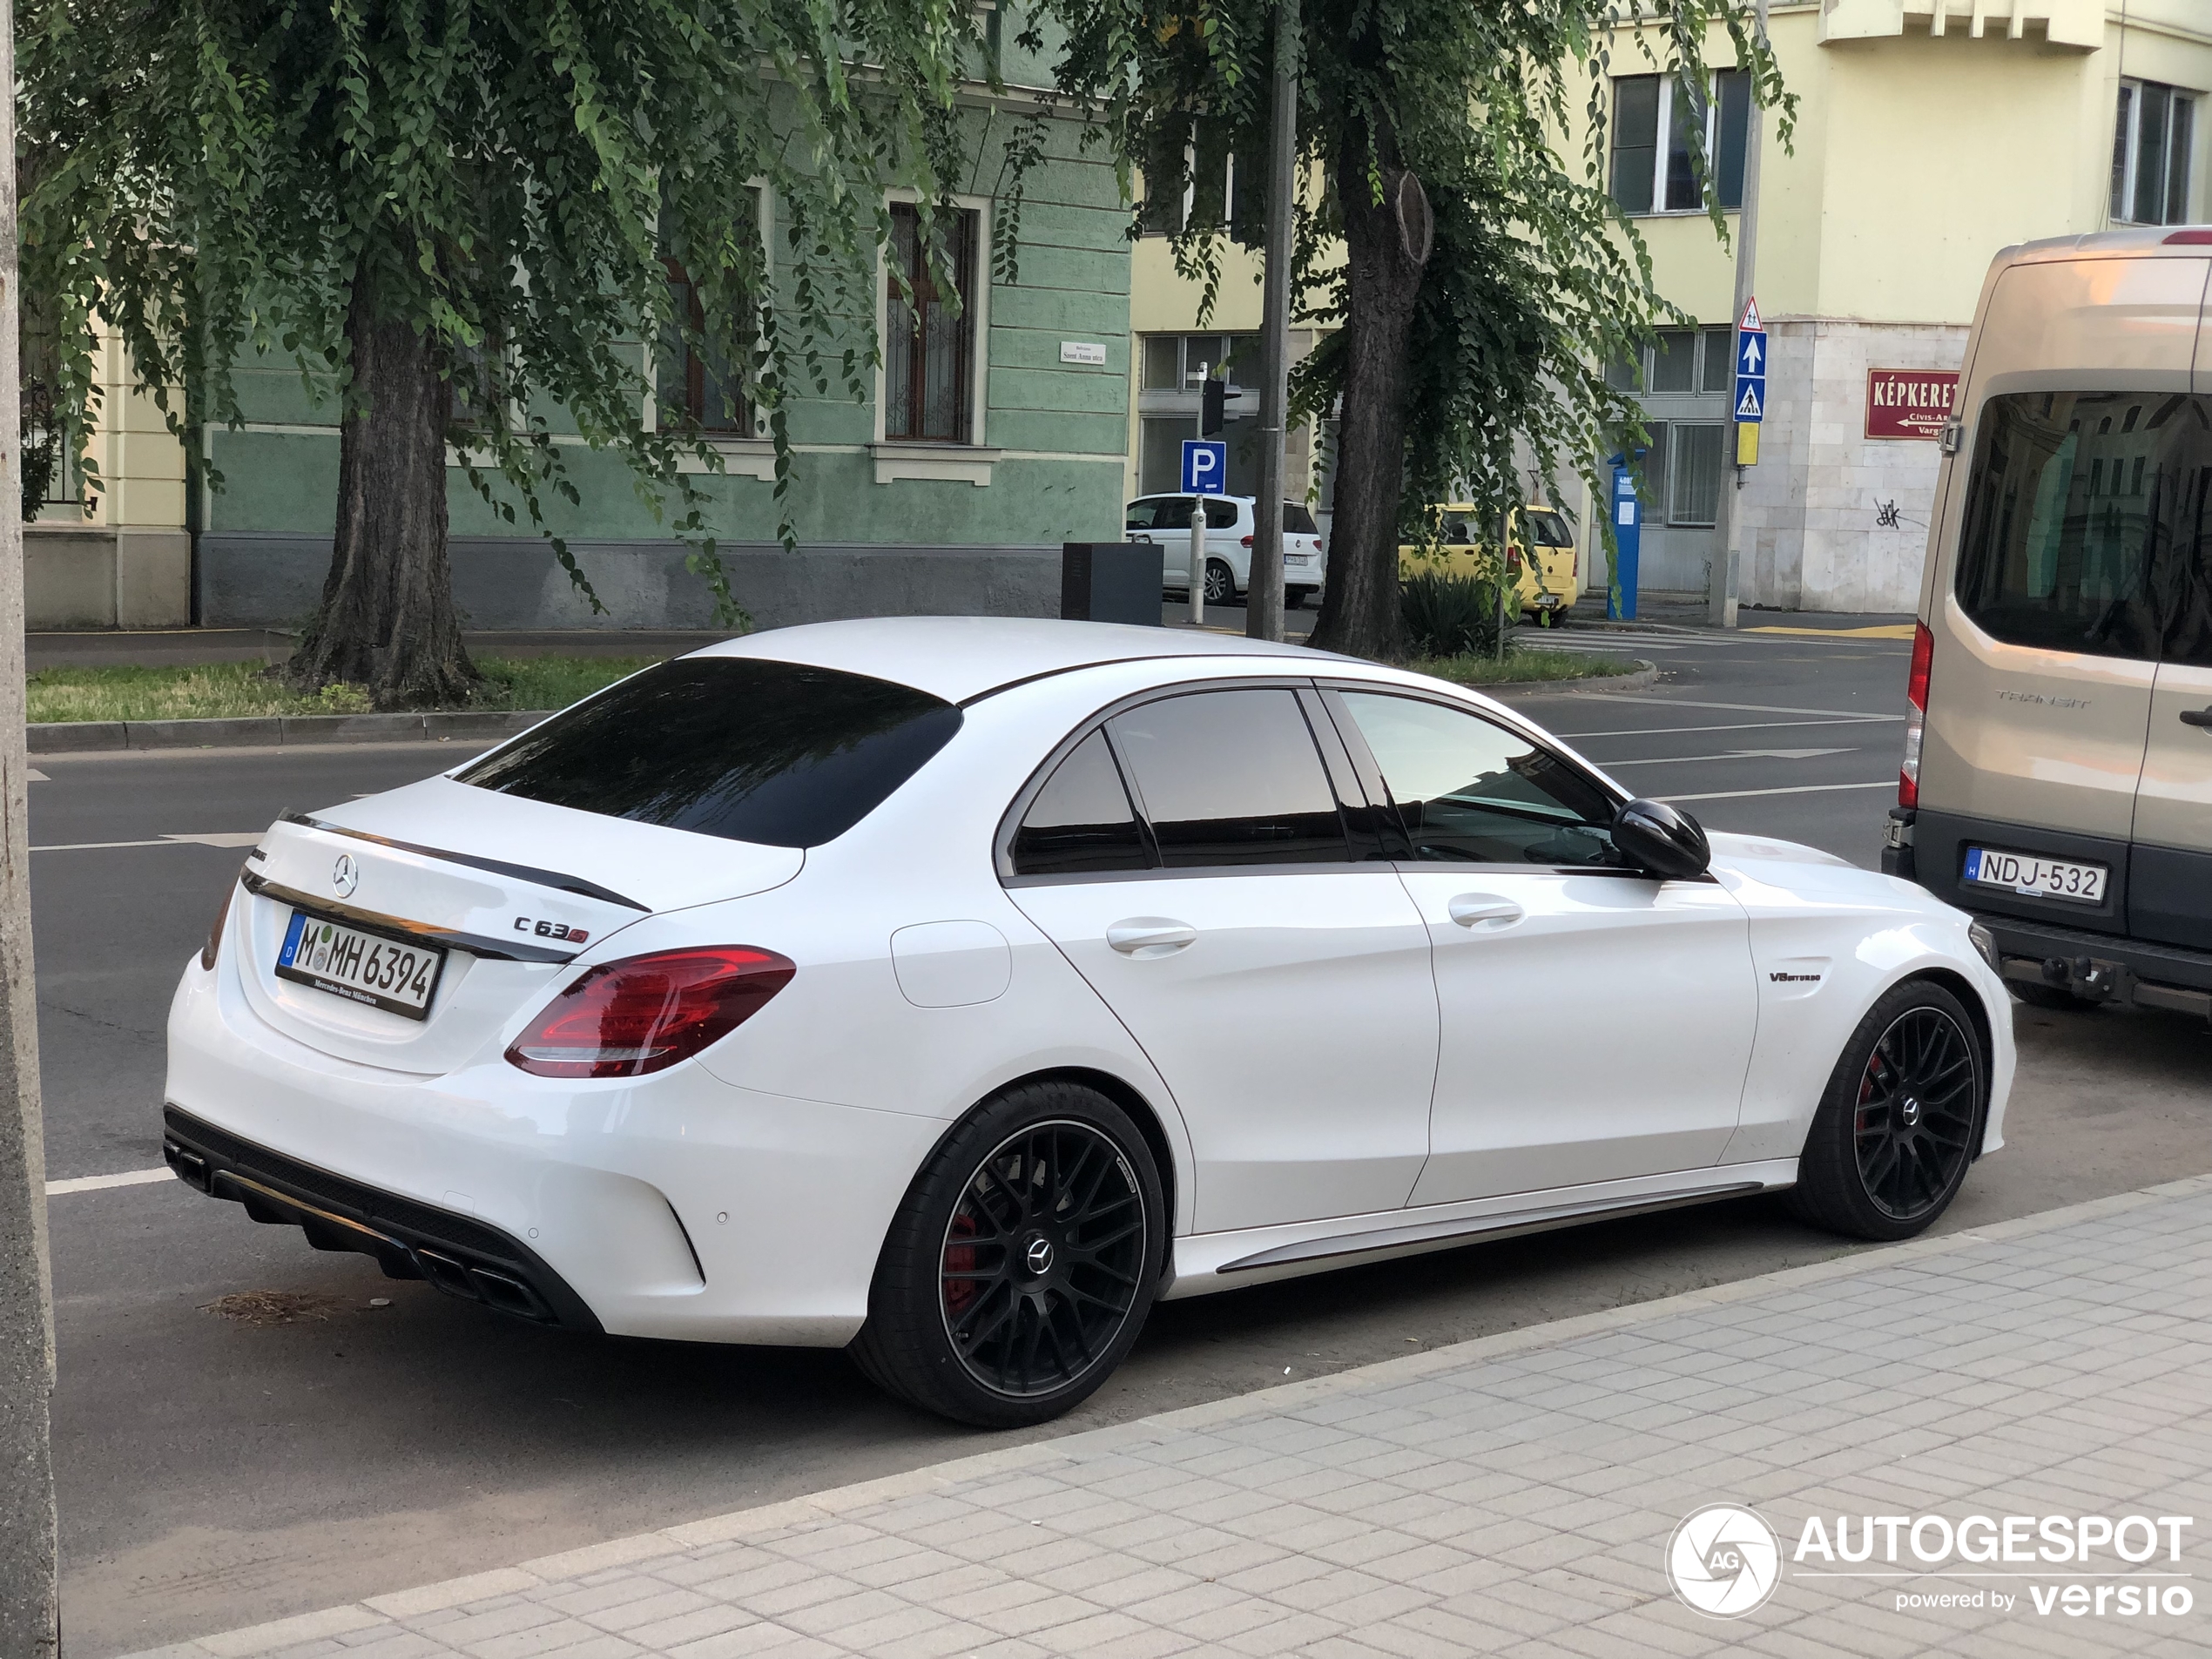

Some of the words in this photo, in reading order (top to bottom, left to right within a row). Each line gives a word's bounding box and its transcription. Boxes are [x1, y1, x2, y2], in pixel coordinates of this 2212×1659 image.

[1192, 448, 1216, 487] P
[1994, 689, 2092, 709] TRANSIT
[1968, 867, 1976, 876] H
[1983, 854, 2098, 897] NDJ-532
[514, 916, 531, 931] C
[286, 946, 293, 959] D
[296, 923, 320, 967] M
[326, 932, 366, 981] MH
[363, 943, 432, 1001] 6394
[314, 979, 352, 997] Mercedes-Benz
[352, 990, 377, 1005] München
